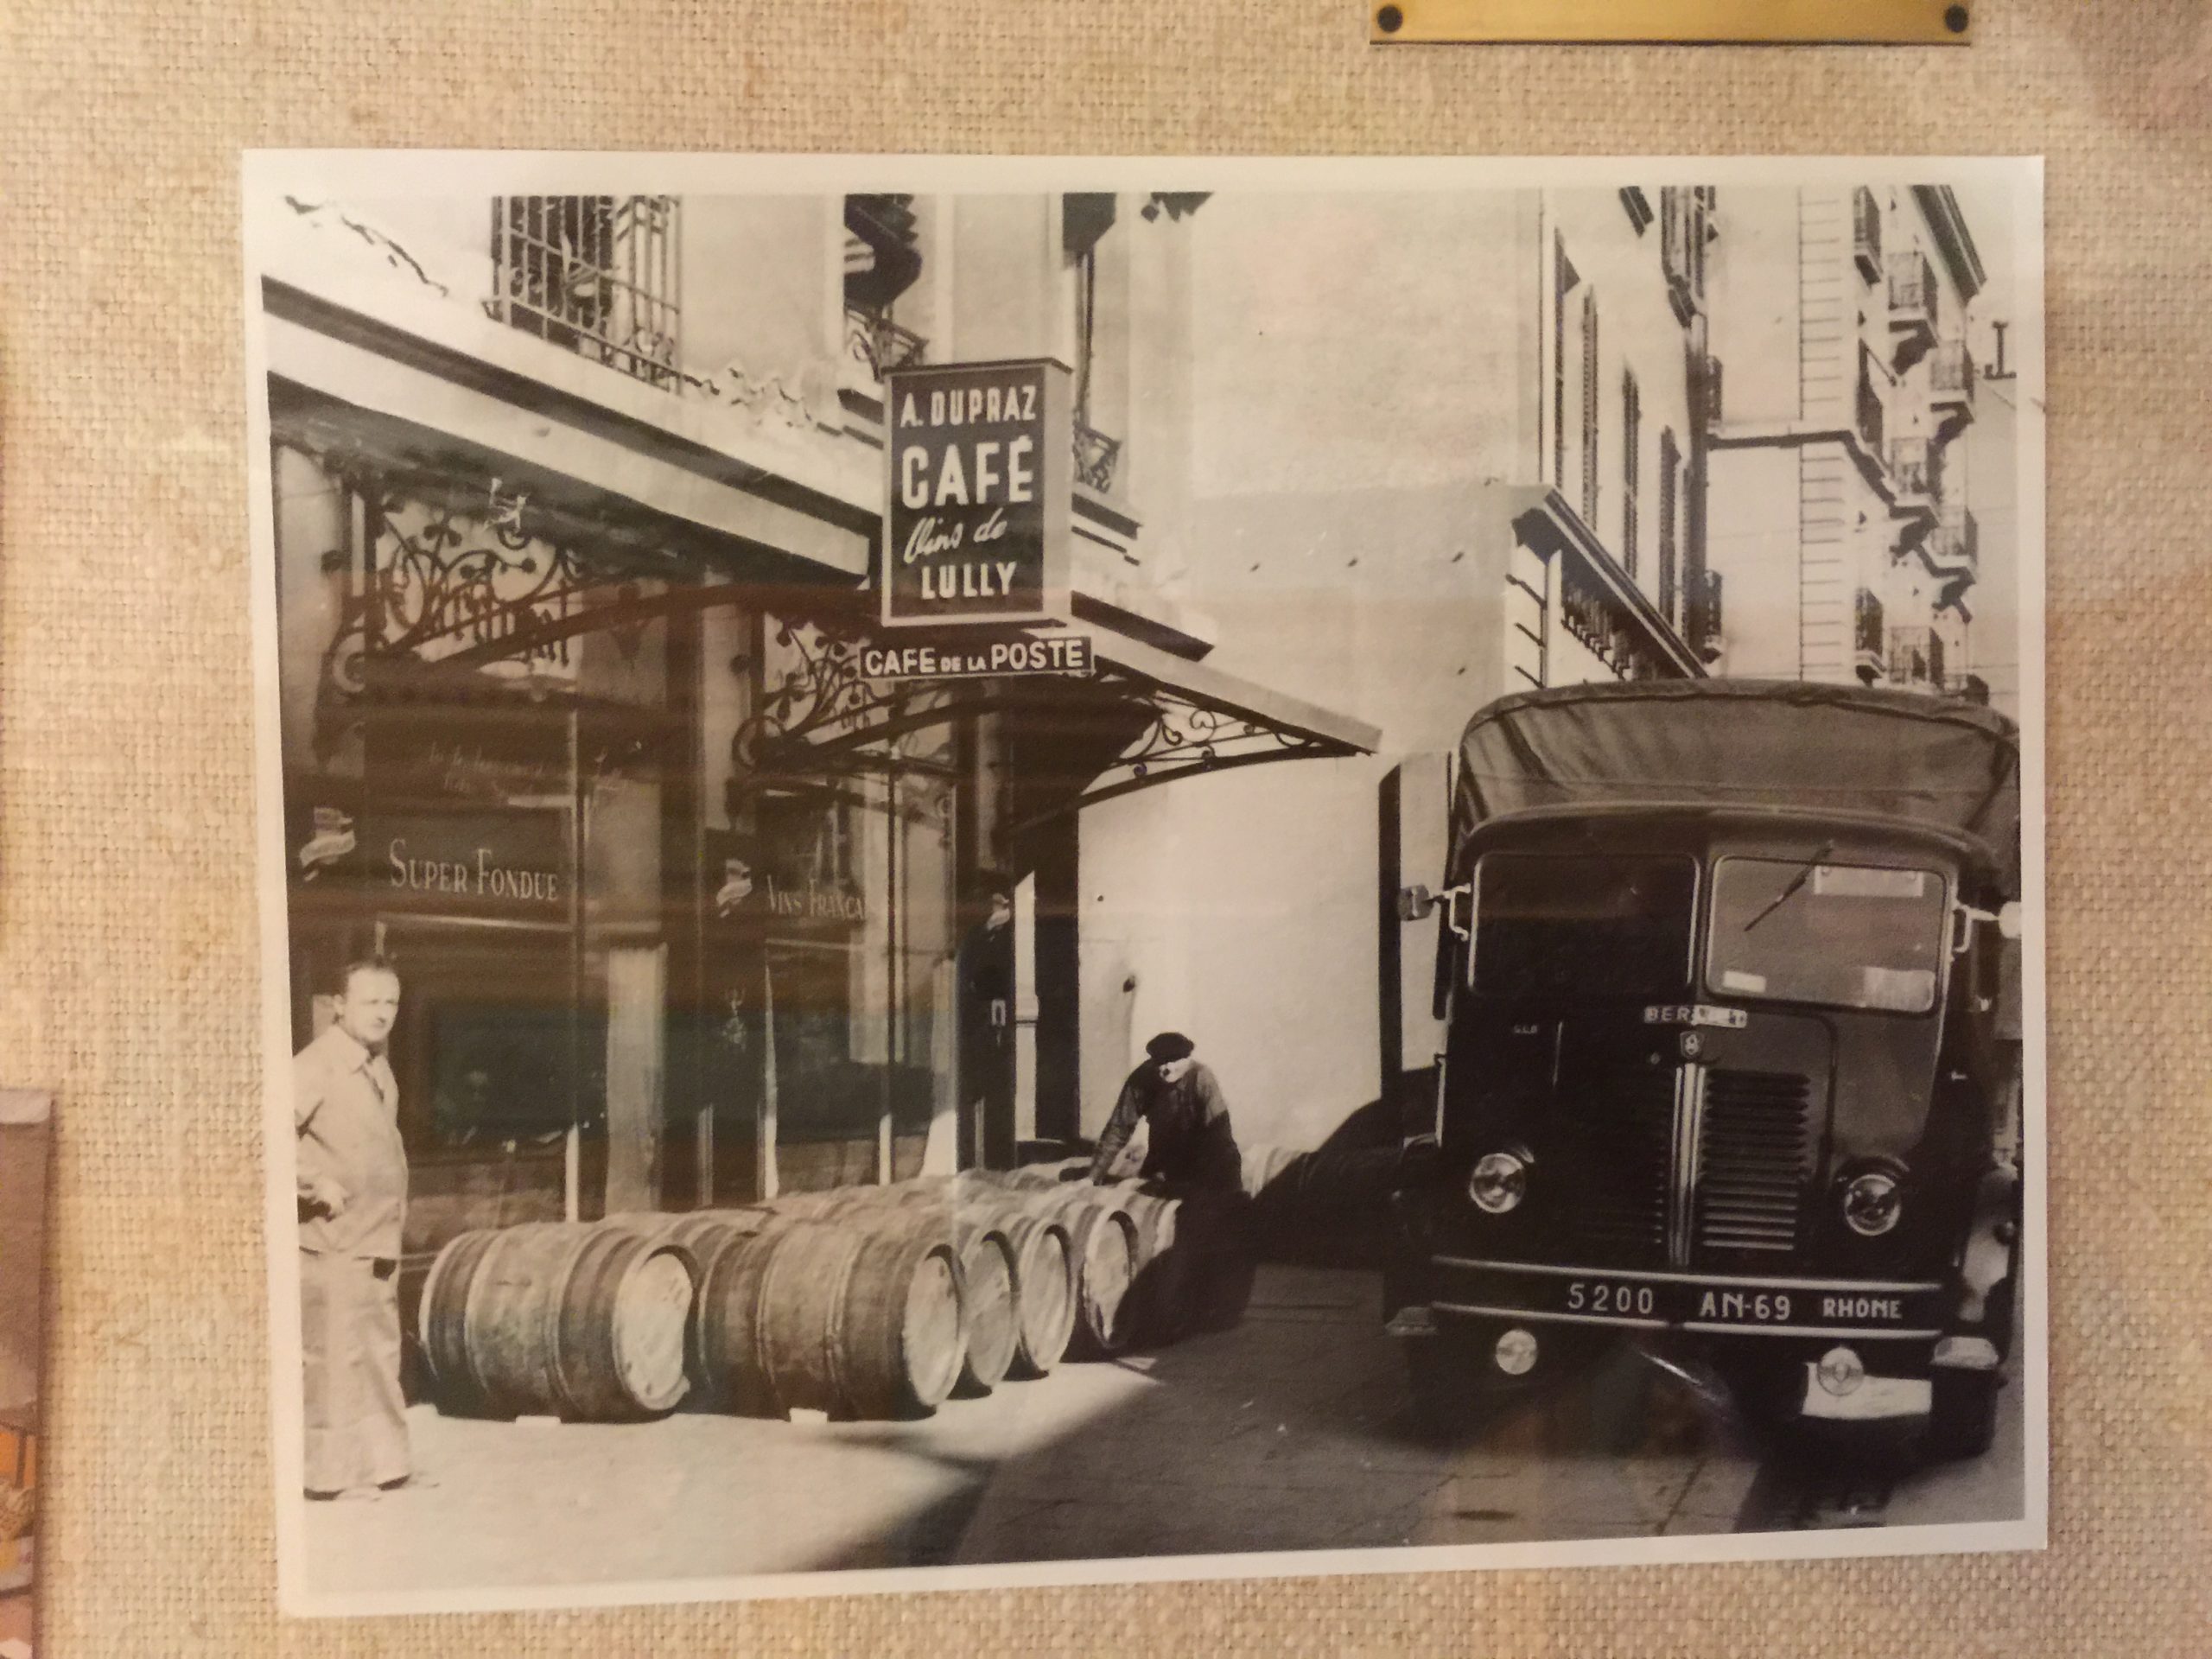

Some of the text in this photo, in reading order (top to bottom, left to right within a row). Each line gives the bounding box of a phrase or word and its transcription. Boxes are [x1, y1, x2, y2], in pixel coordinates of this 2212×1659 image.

[900, 385, 1036, 427] A. DUPRAZ
[902, 435, 1033, 508] CAFÉ
[973, 508, 1007, 543] de
[921, 563, 1017, 599] LULLY
[865, 639, 1084, 676] CAFE DE LA POSTE
[1568, 1283, 1901, 1320] 5200 AN-69 RHONE
